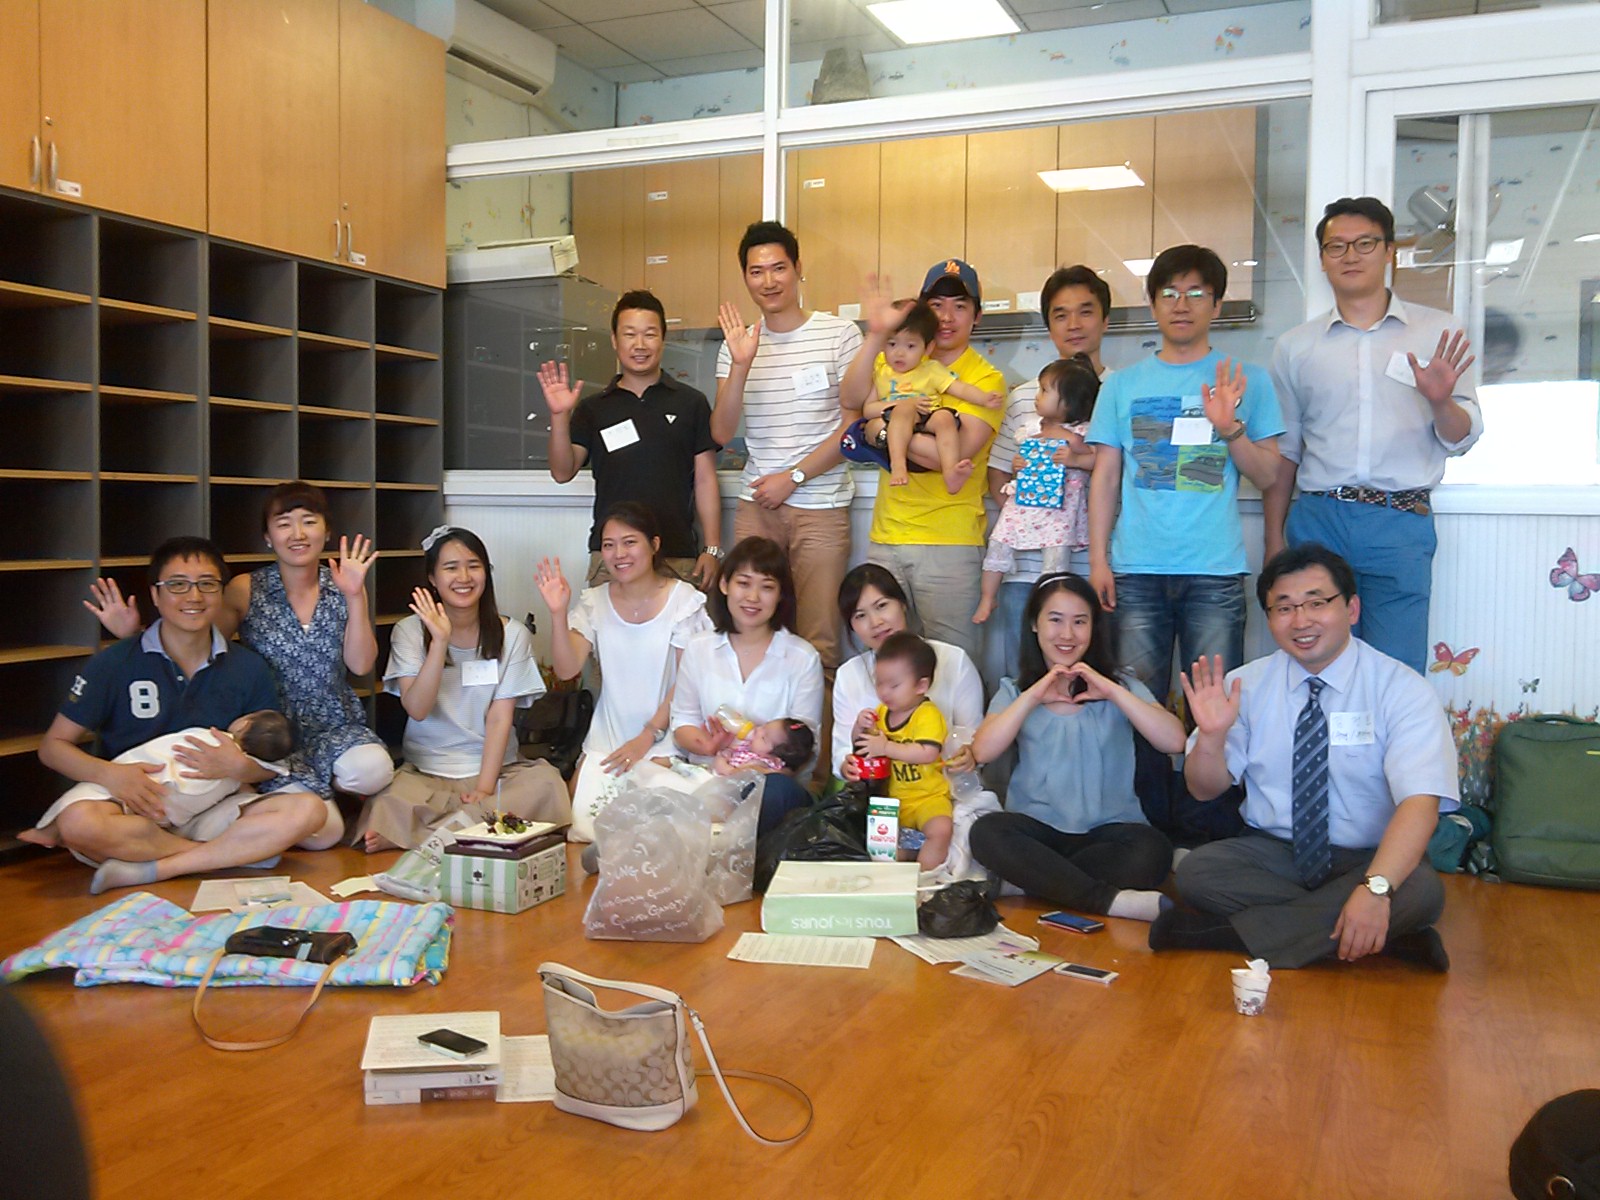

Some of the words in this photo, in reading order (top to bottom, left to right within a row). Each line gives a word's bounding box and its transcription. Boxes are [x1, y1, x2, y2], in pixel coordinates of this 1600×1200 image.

[129, 680, 160, 719] 8
[893, 763, 922, 782] ME
[791, 915, 835, 929] JOURS
[856, 917, 893, 929] TOUS
